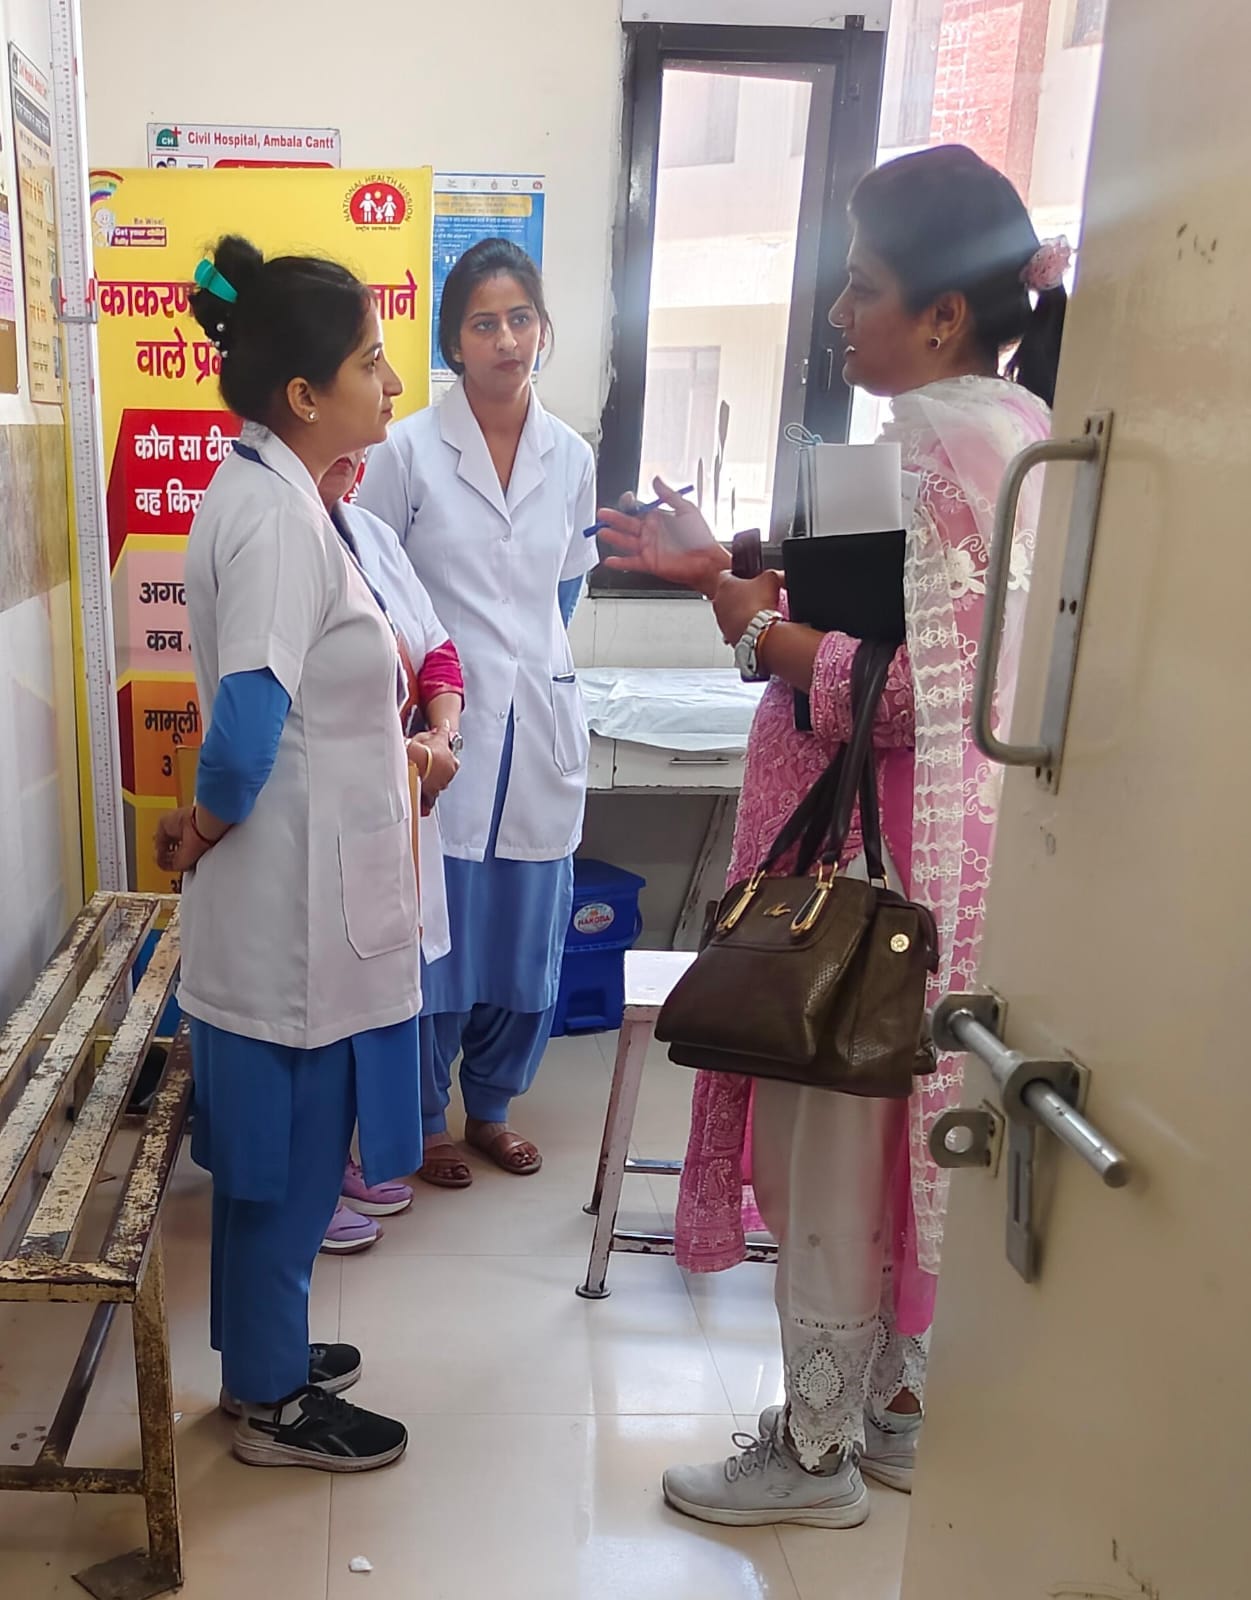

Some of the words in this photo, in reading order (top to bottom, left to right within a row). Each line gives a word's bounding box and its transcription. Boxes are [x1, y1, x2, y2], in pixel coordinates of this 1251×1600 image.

[161, 137, 174, 145] CH
[187, 131, 211, 145] Civil
[214, 132, 261, 149] Hospital,
[263, 134, 303, 148] Ambala
[306, 135, 335, 149] Cantt
[343, 180, 364, 222] NATIONAL
[364, 174, 398, 187] HEALTH
[398, 183, 414, 222] MISSION
[96, 280, 196, 319] काकरण
[136, 326, 188, 379] वाले
[134, 424, 175, 460] कौन
[178, 435, 202, 461] सा
[134, 488, 163, 516] वह
[145, 630, 184, 652] कब
[144, 701, 199, 745] मामूली
